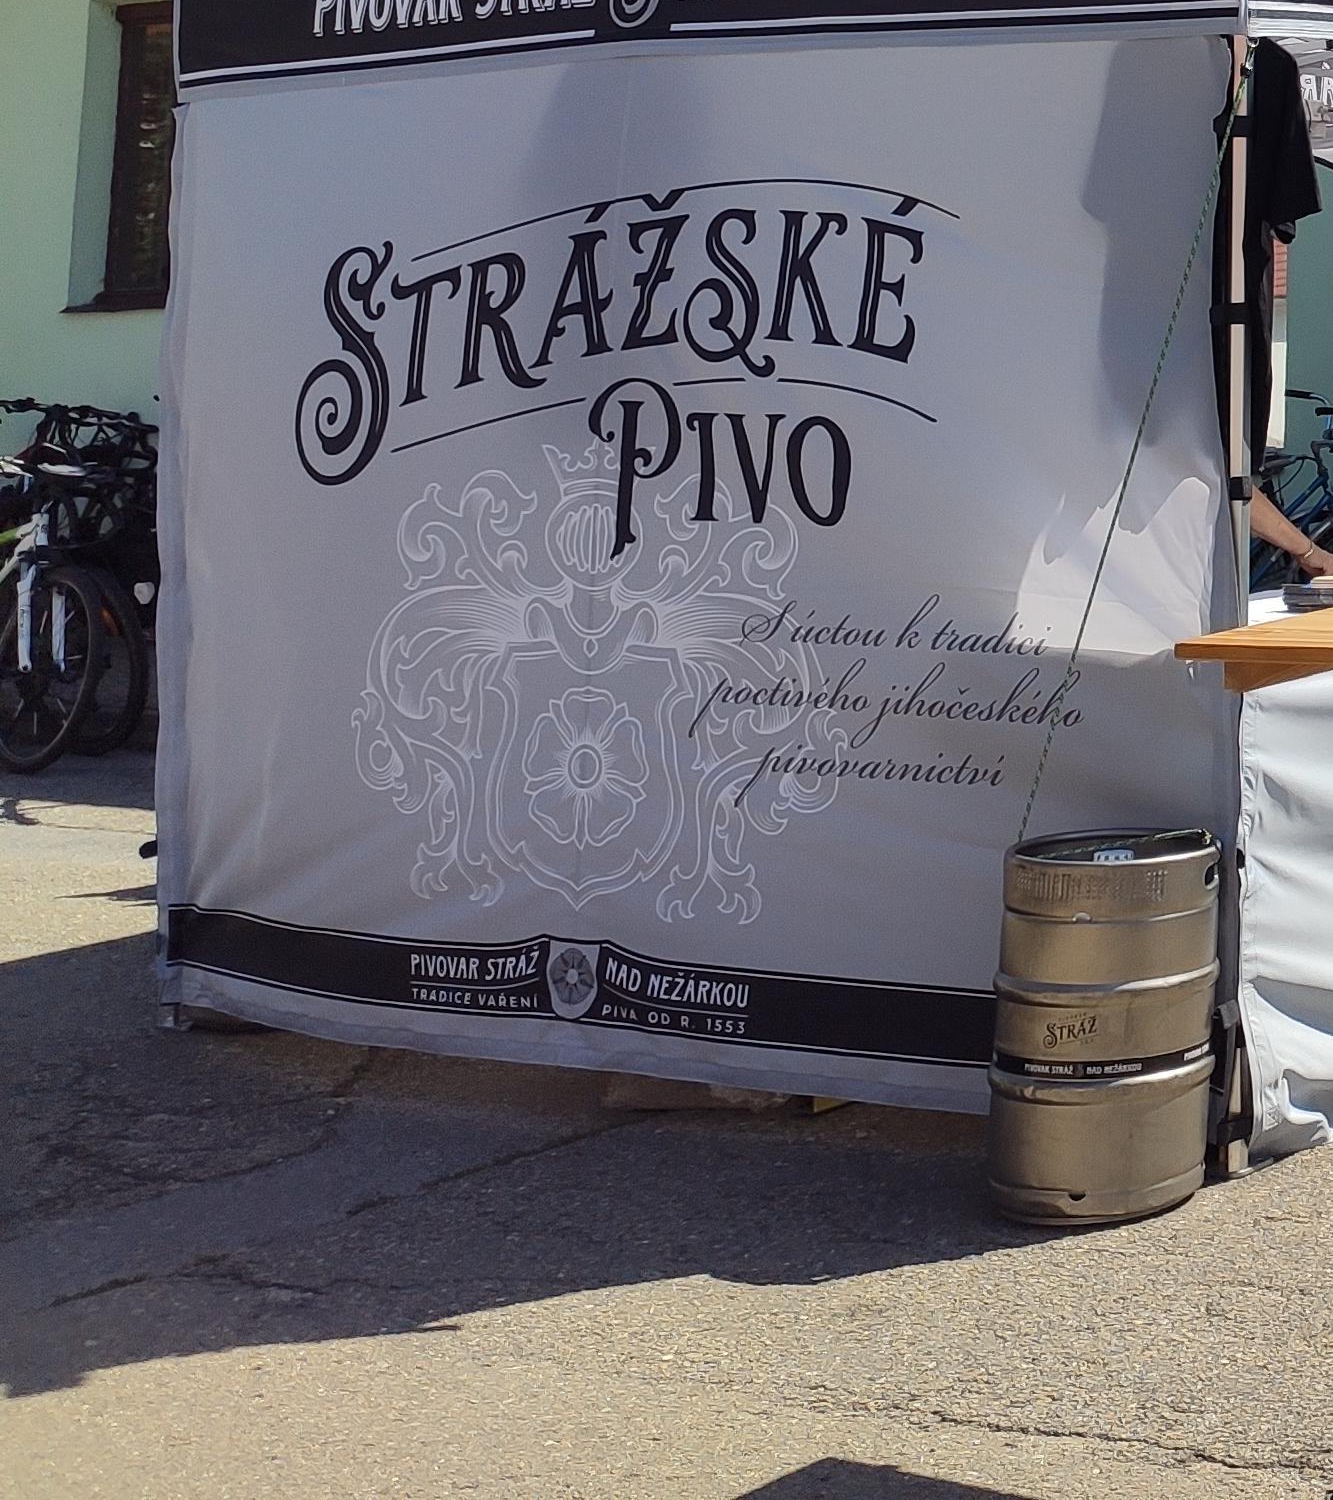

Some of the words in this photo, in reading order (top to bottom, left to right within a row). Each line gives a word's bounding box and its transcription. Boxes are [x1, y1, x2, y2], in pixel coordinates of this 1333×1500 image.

[296, 190, 926, 486] STRÁŽSKÉ
[589, 377, 852, 560] PIVO
[790, 609, 886, 647] úctou
[896, 594, 941, 648] k
[931, 612, 1053, 656] tradici
[689, 658, 870, 739] poctivého
[850, 661, 1085, 748] jihočeského
[735, 745, 1007, 808] pivovarnictví
[411, 952, 478, 981] PIVOVAR
[484, 945, 540, 978] STRÁŽ
[605, 957, 642, 993] NAD
[647, 971, 750, 1009] NEŽÁRKOU
[412, 988, 472, 1007] TRADICE
[478, 988, 539, 1009] VAŘENÍ
[602, 1004, 637, 1020] PIVA
[648, 1010, 671, 1026] OD
[706, 1018, 747, 1035] 1553
[1043, 1016, 1097, 1049] STRÁŽ
